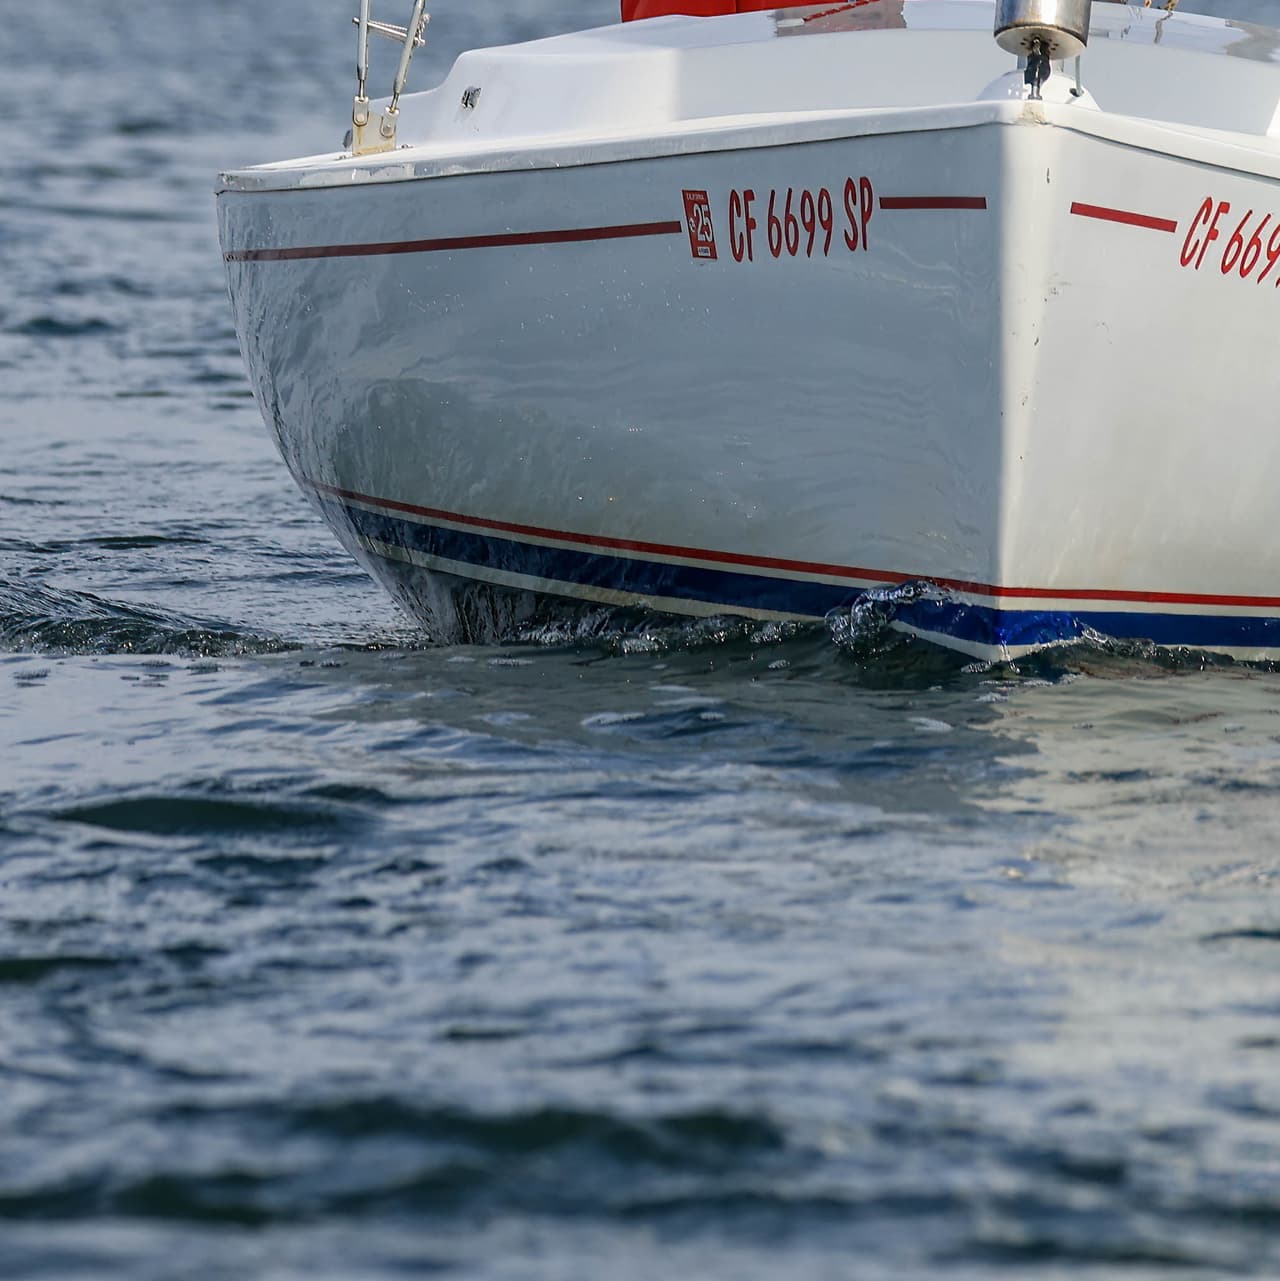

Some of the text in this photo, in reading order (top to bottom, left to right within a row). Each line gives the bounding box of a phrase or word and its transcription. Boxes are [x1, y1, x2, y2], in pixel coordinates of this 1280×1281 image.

[694, 203, 713, 242] 25
[729, 176, 873, 263] CF 6699 SP
[1180, 197, 1230, 270] CF
